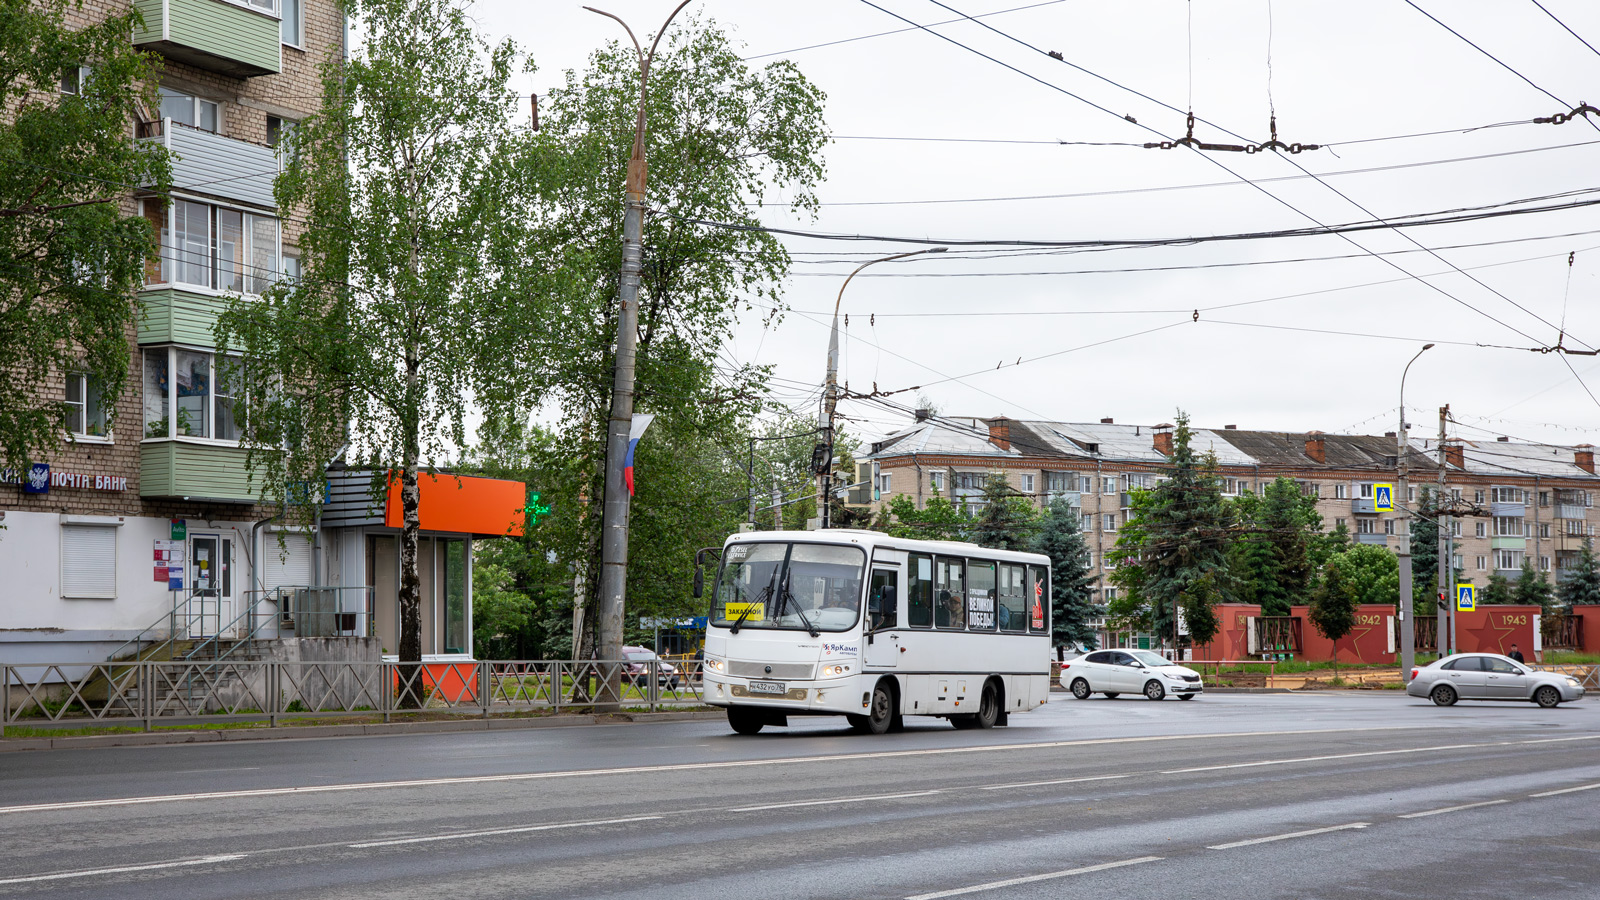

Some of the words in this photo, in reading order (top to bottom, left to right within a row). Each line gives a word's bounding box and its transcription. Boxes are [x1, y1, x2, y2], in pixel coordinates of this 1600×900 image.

[51, 472, 90, 489] ПОЧТА
[95, 475, 127, 491] БАНК
[969, 596, 994, 612] ВЕЛИКОЙ
[1357, 615, 1380, 625] 1942
[1502, 615, 1526, 625] 1943
[830, 643, 858, 652] ЯрКамп
